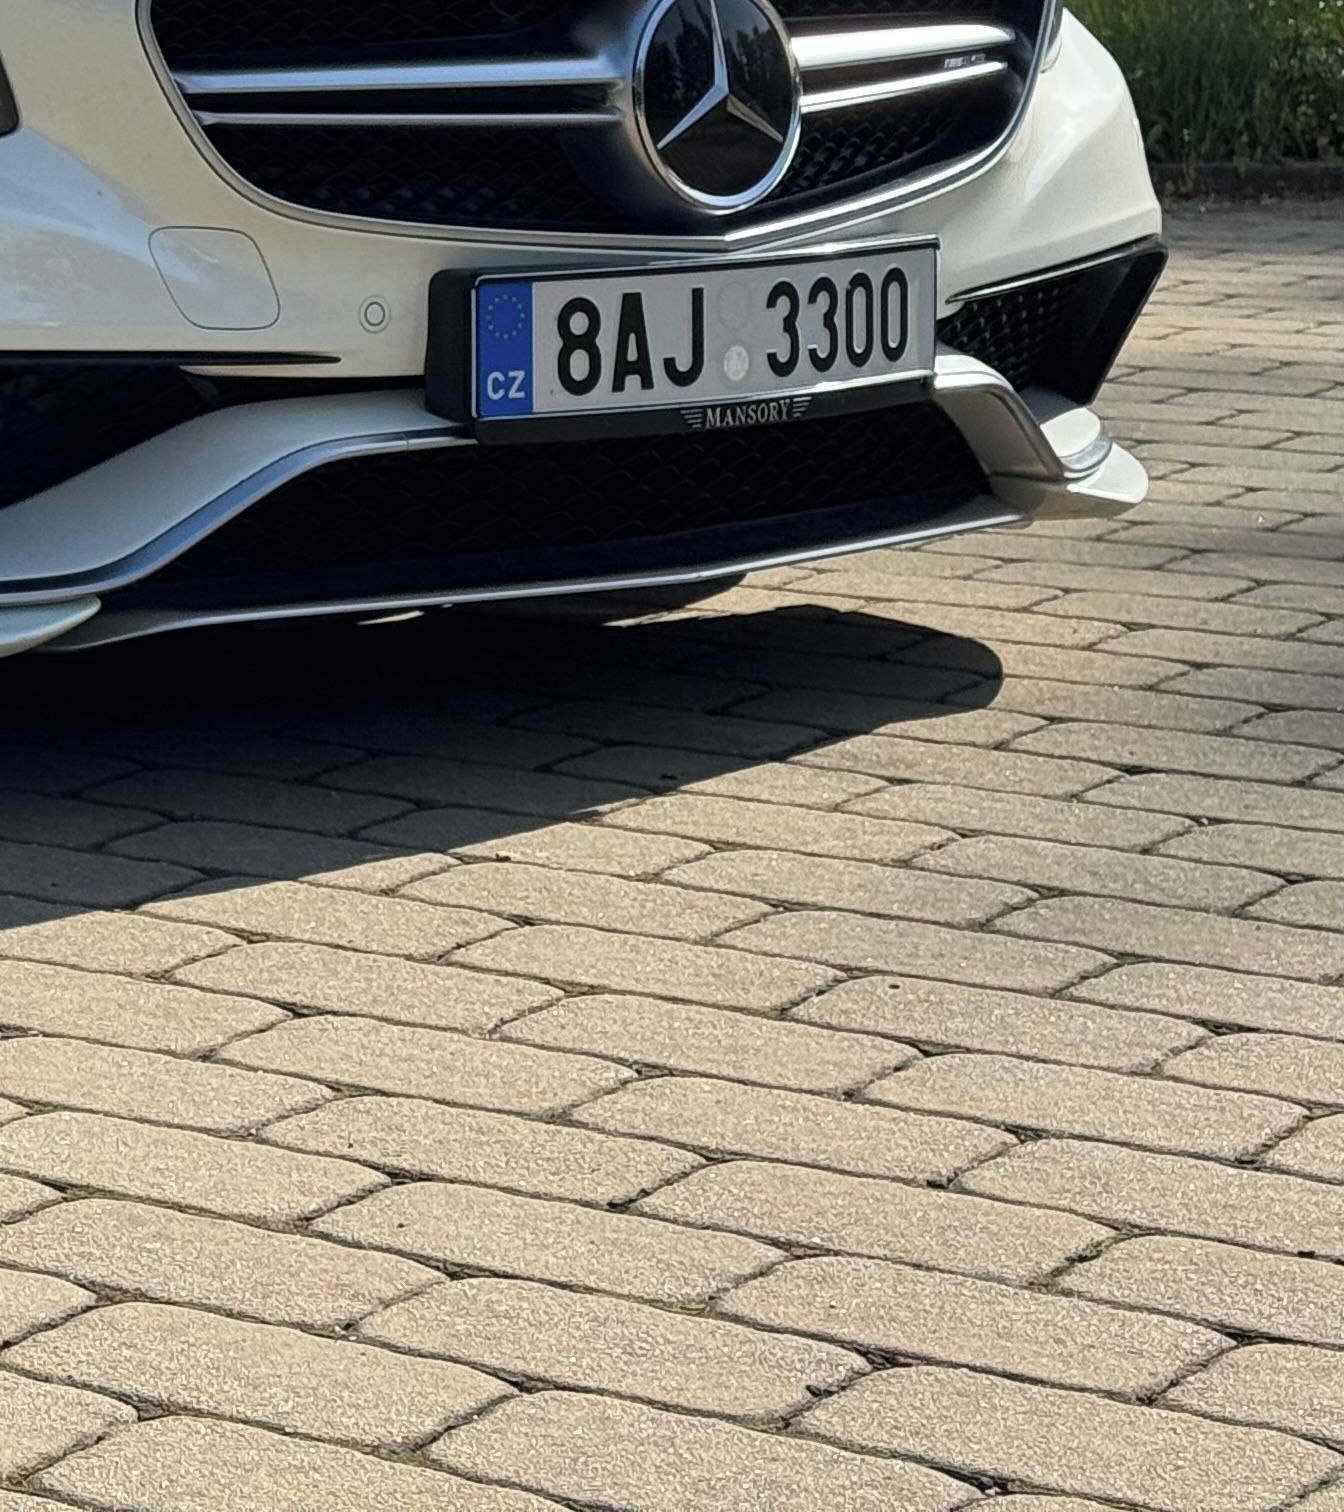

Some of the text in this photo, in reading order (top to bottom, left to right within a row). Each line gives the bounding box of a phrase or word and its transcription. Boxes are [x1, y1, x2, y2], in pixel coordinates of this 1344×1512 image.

[556, 266, 909, 396] 8AJ 3300
[486, 370, 525, 400] CZ
[705, 399, 791, 429] MANSORY
